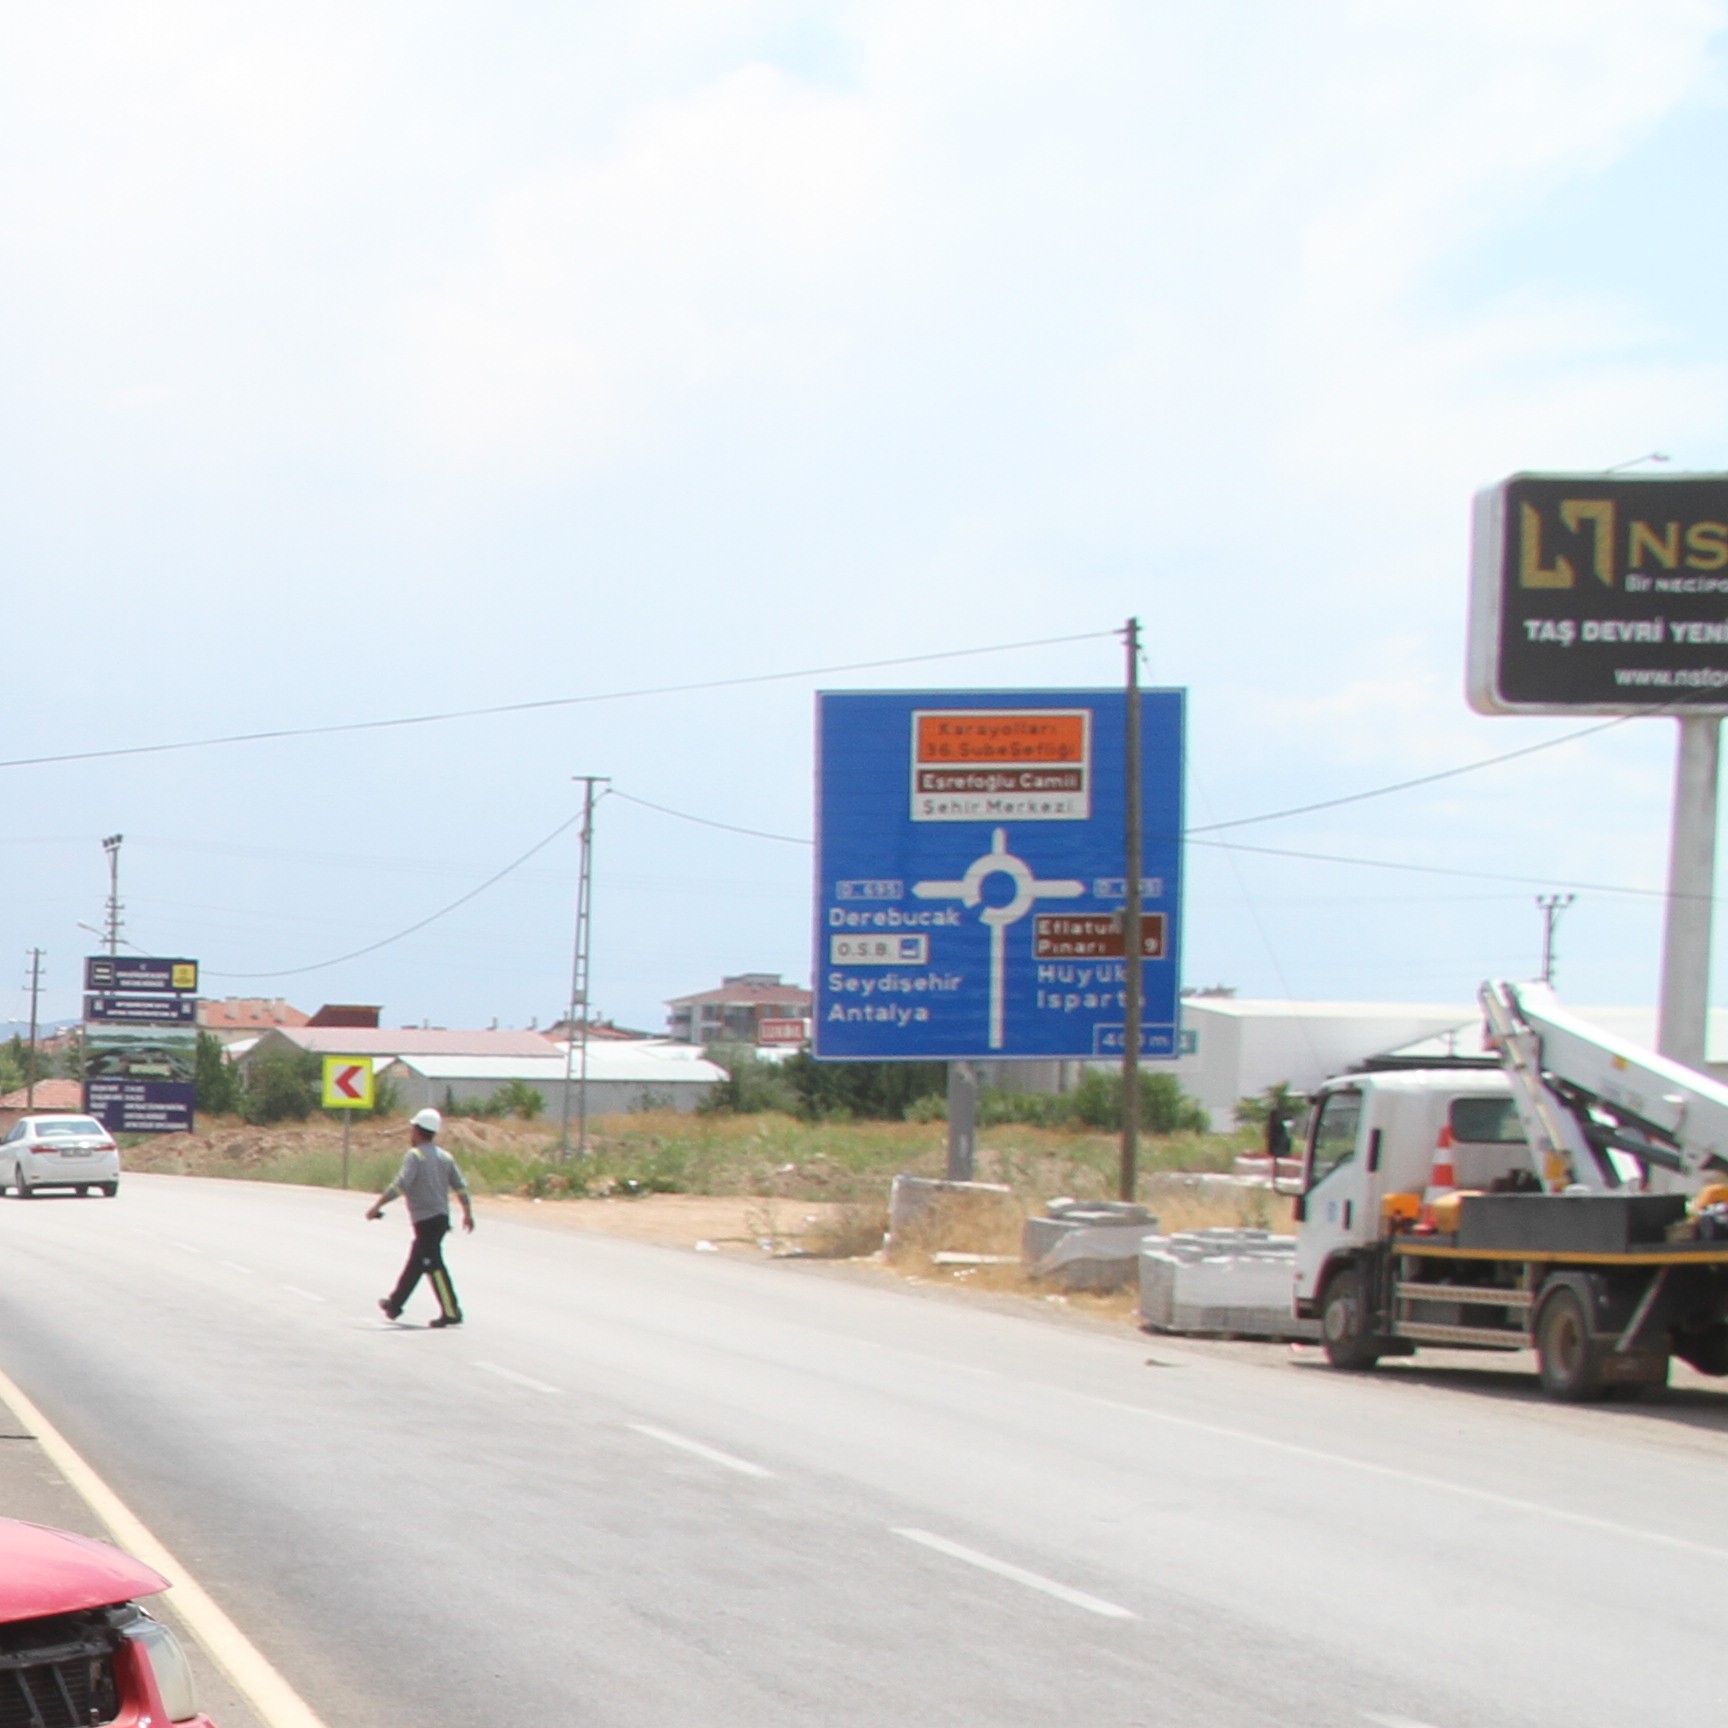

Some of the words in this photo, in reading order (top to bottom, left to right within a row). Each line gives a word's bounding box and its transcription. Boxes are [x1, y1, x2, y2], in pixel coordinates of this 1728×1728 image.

[1523, 619, 1577, 648] TAŞ
[1581, 615, 1665, 642] DEVRİ
[985, 799, 1074, 813] Merkezi
[829, 907, 960, 927] Derebucak
[1144, 938, 1158, 953] 9
[828, 972, 964, 997] Seydişehir
[1037, 964, 1129, 989] Hüyük
[828, 1003, 929, 1028] Antalya
